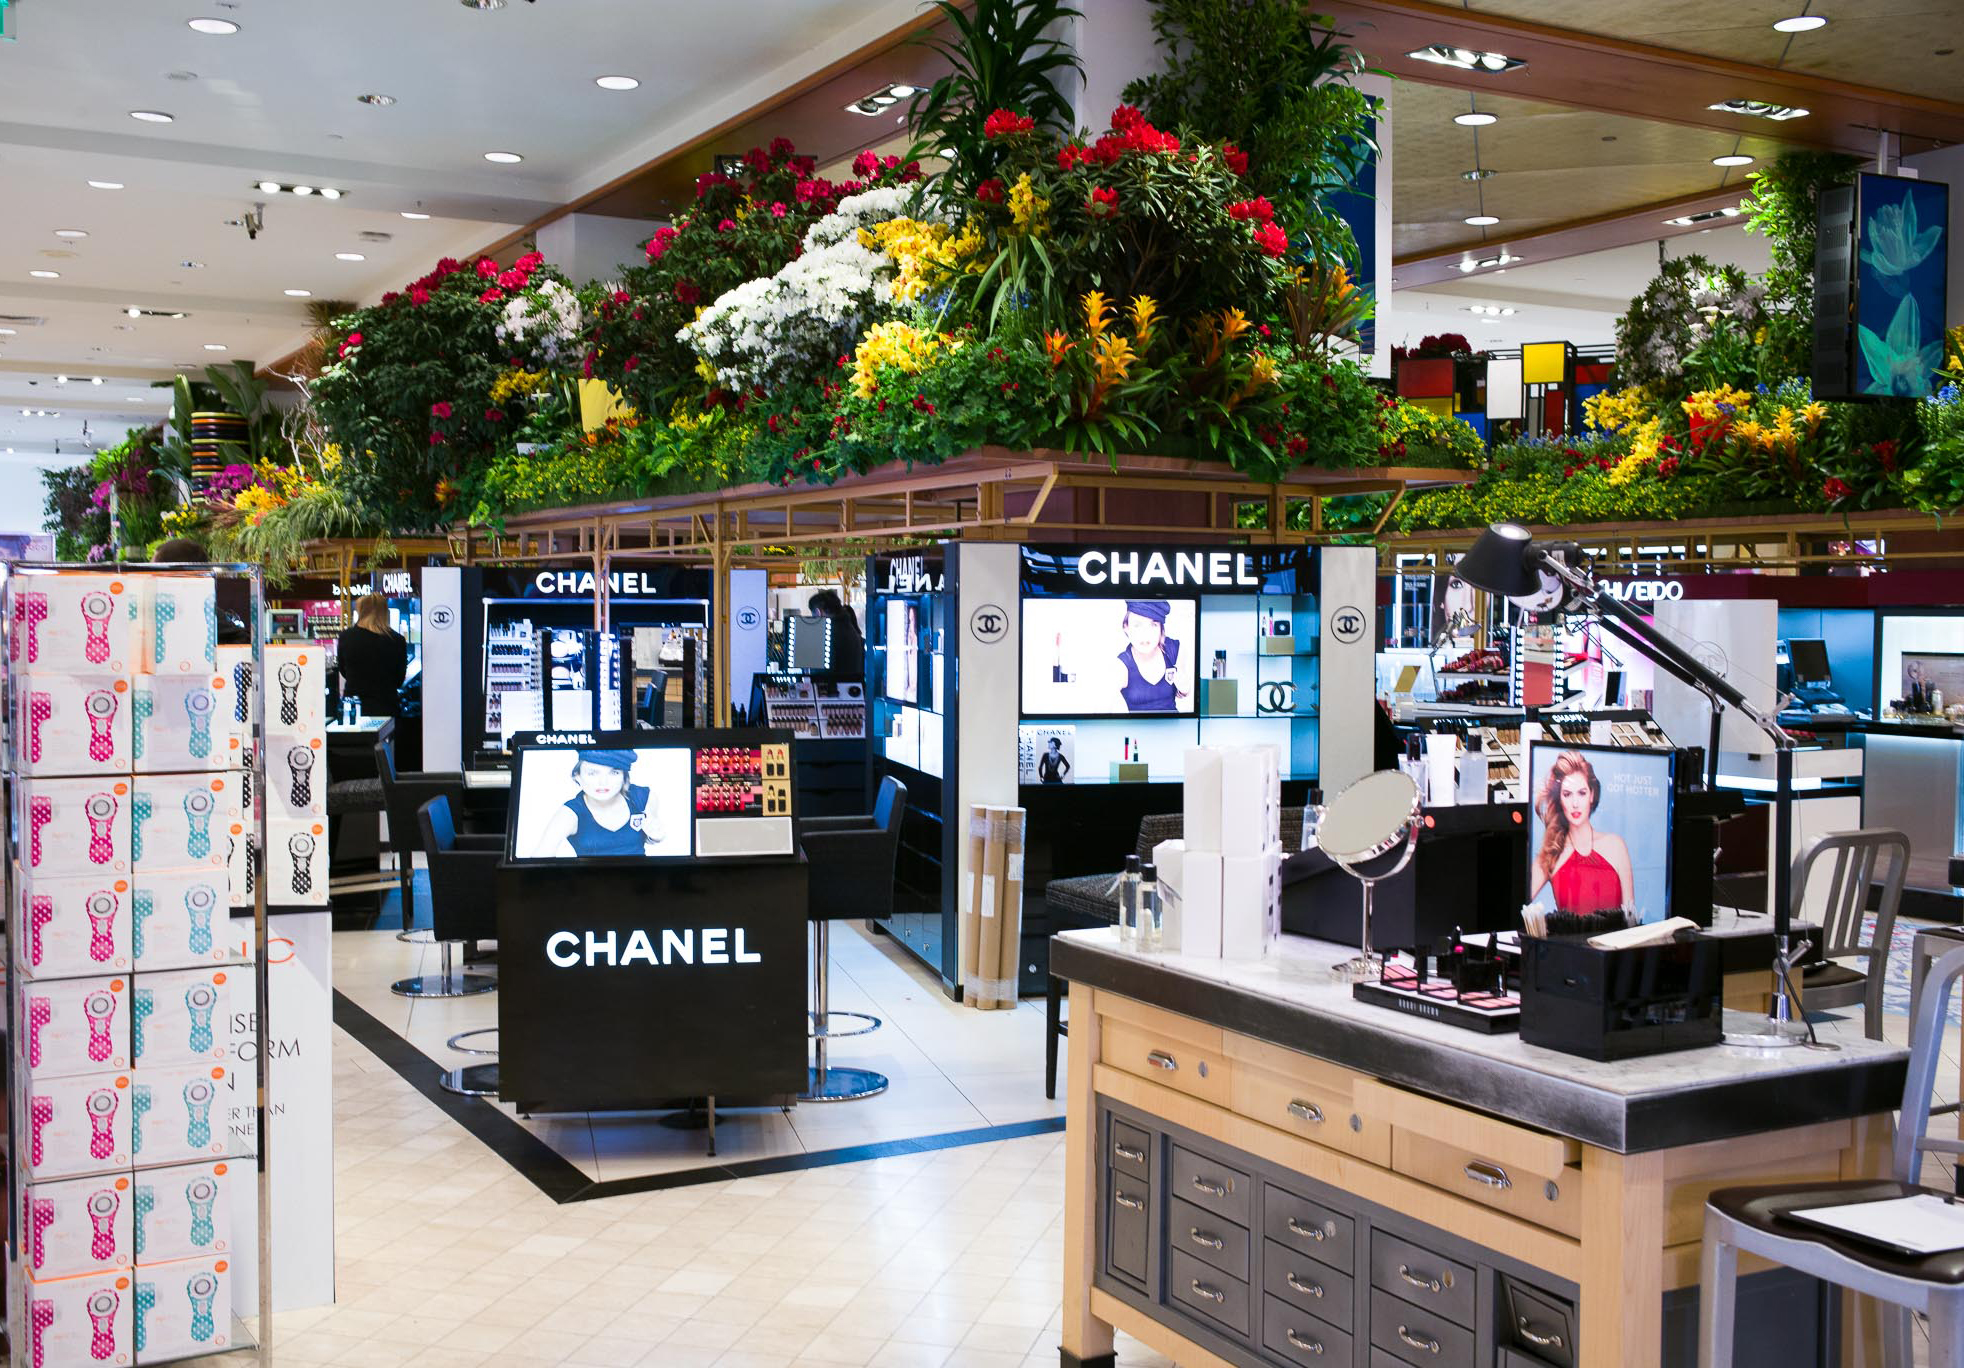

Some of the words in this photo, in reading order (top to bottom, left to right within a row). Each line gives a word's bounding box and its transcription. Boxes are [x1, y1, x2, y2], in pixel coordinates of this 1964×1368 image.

[1078, 551, 1259, 585] CHANEL
[382, 572, 413, 594] CHANEL
[535, 571, 657, 594] CHANEL
[535, 733, 597, 745] CHANEL
[1606, 783, 1624, 793] GOT
[1628, 785, 1660, 797] HOTTER
[1613, 773, 1631, 784] HOT
[1634, 775, 1653, 785] JUST
[546, 927, 762, 968] CHANEL
[229, 1012, 257, 1034] ISE
